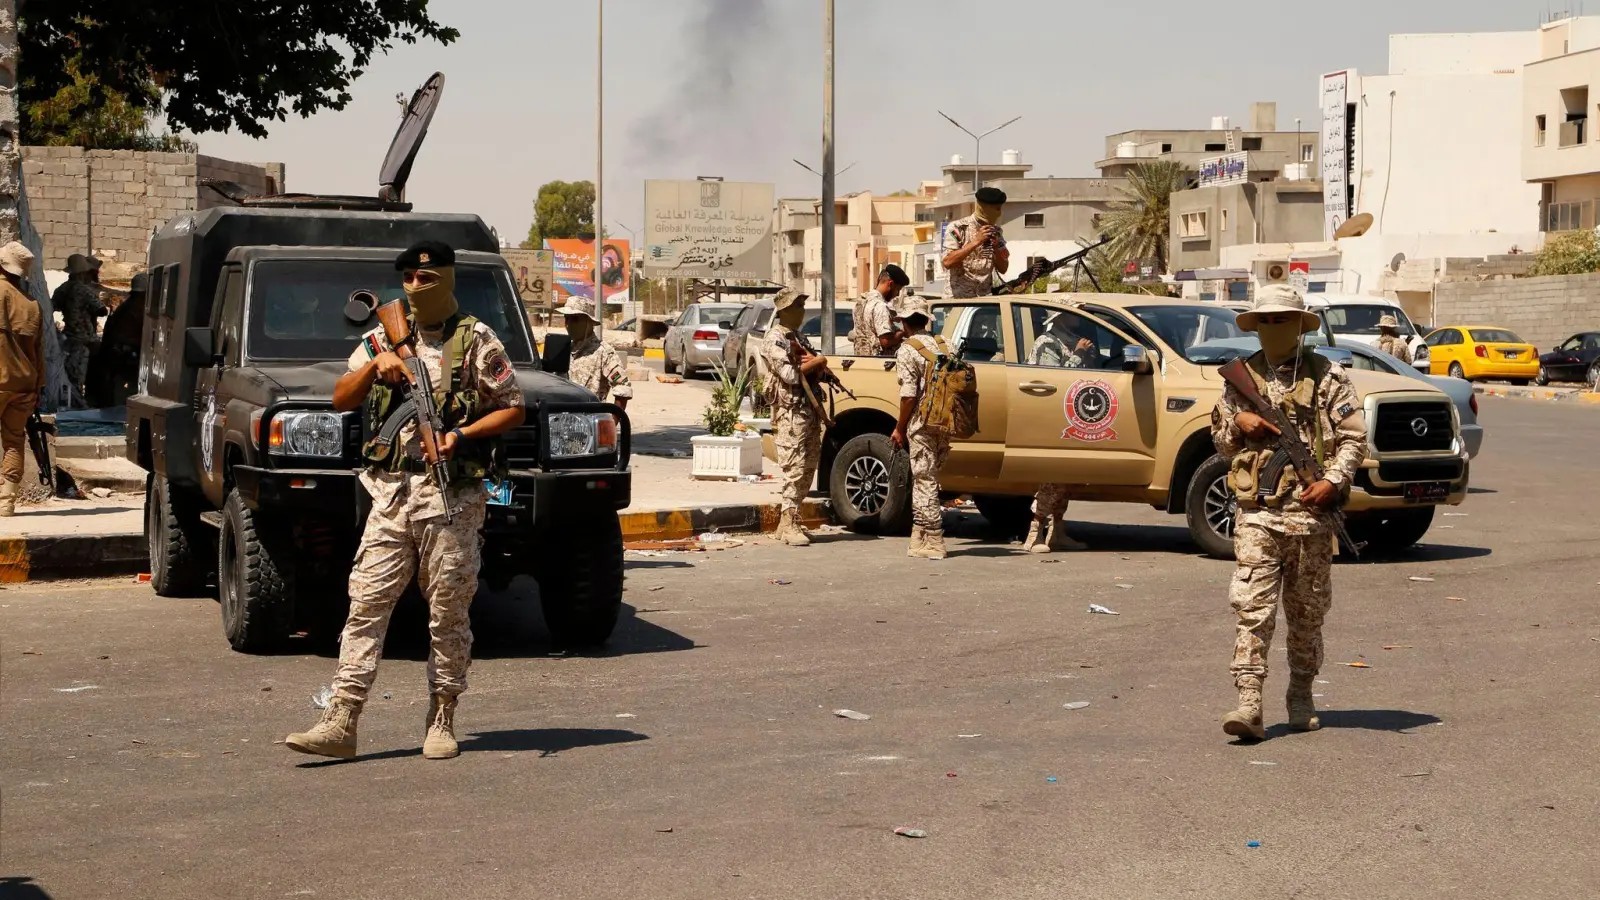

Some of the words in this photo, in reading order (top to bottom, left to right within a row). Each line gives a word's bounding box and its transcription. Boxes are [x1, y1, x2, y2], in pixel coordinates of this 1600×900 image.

[655, 210, 691, 223] العالمية
[694, 209, 727, 223] المعرفة
[730, 210, 764, 225] مدرسة
[654, 223, 683, 233] Global
[685, 224, 732, 235] Knowledge
[734, 225, 764, 235] School
[721, 236, 744, 245] للتعليم
[577, 252, 590, 264] في
[708, 254, 734, 271] غزة
